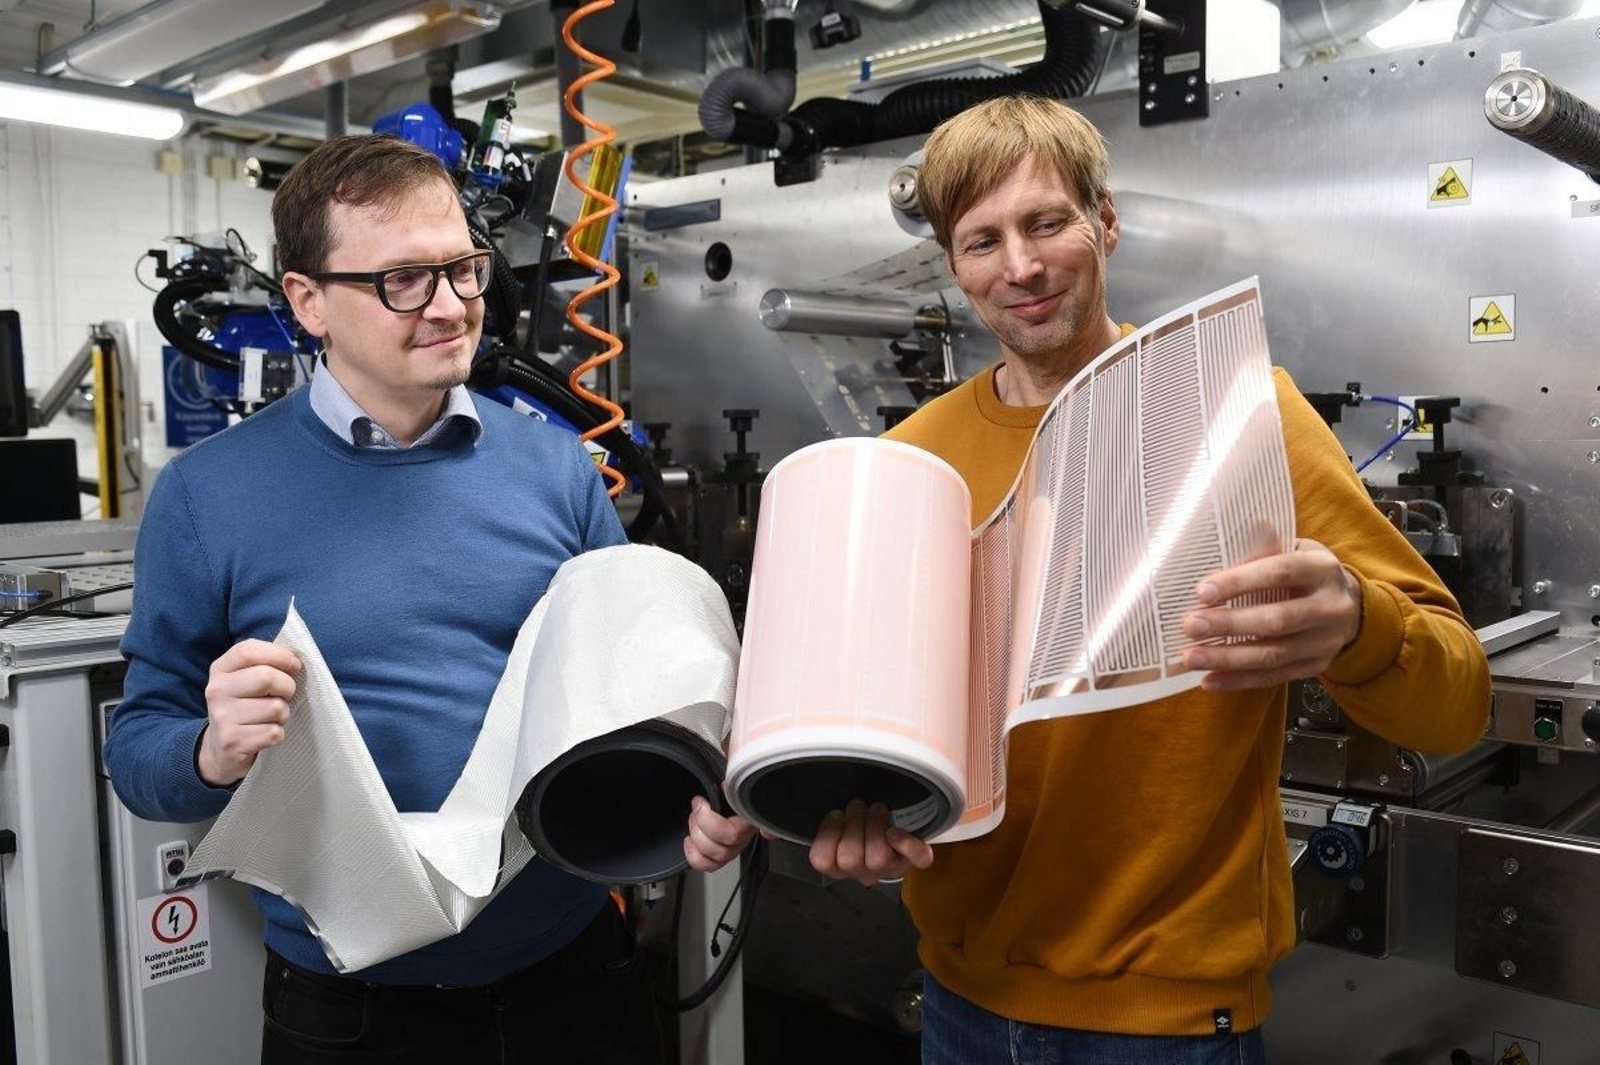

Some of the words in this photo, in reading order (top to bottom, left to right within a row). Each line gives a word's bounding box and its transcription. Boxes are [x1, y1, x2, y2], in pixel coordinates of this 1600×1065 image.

[1301, 810, 1308, 819] 7
[145, 950, 174, 963] Kotelon
[175, 945, 187, 955] saa
[189, 940, 209, 950] avata
[150, 961, 166, 970] vain
